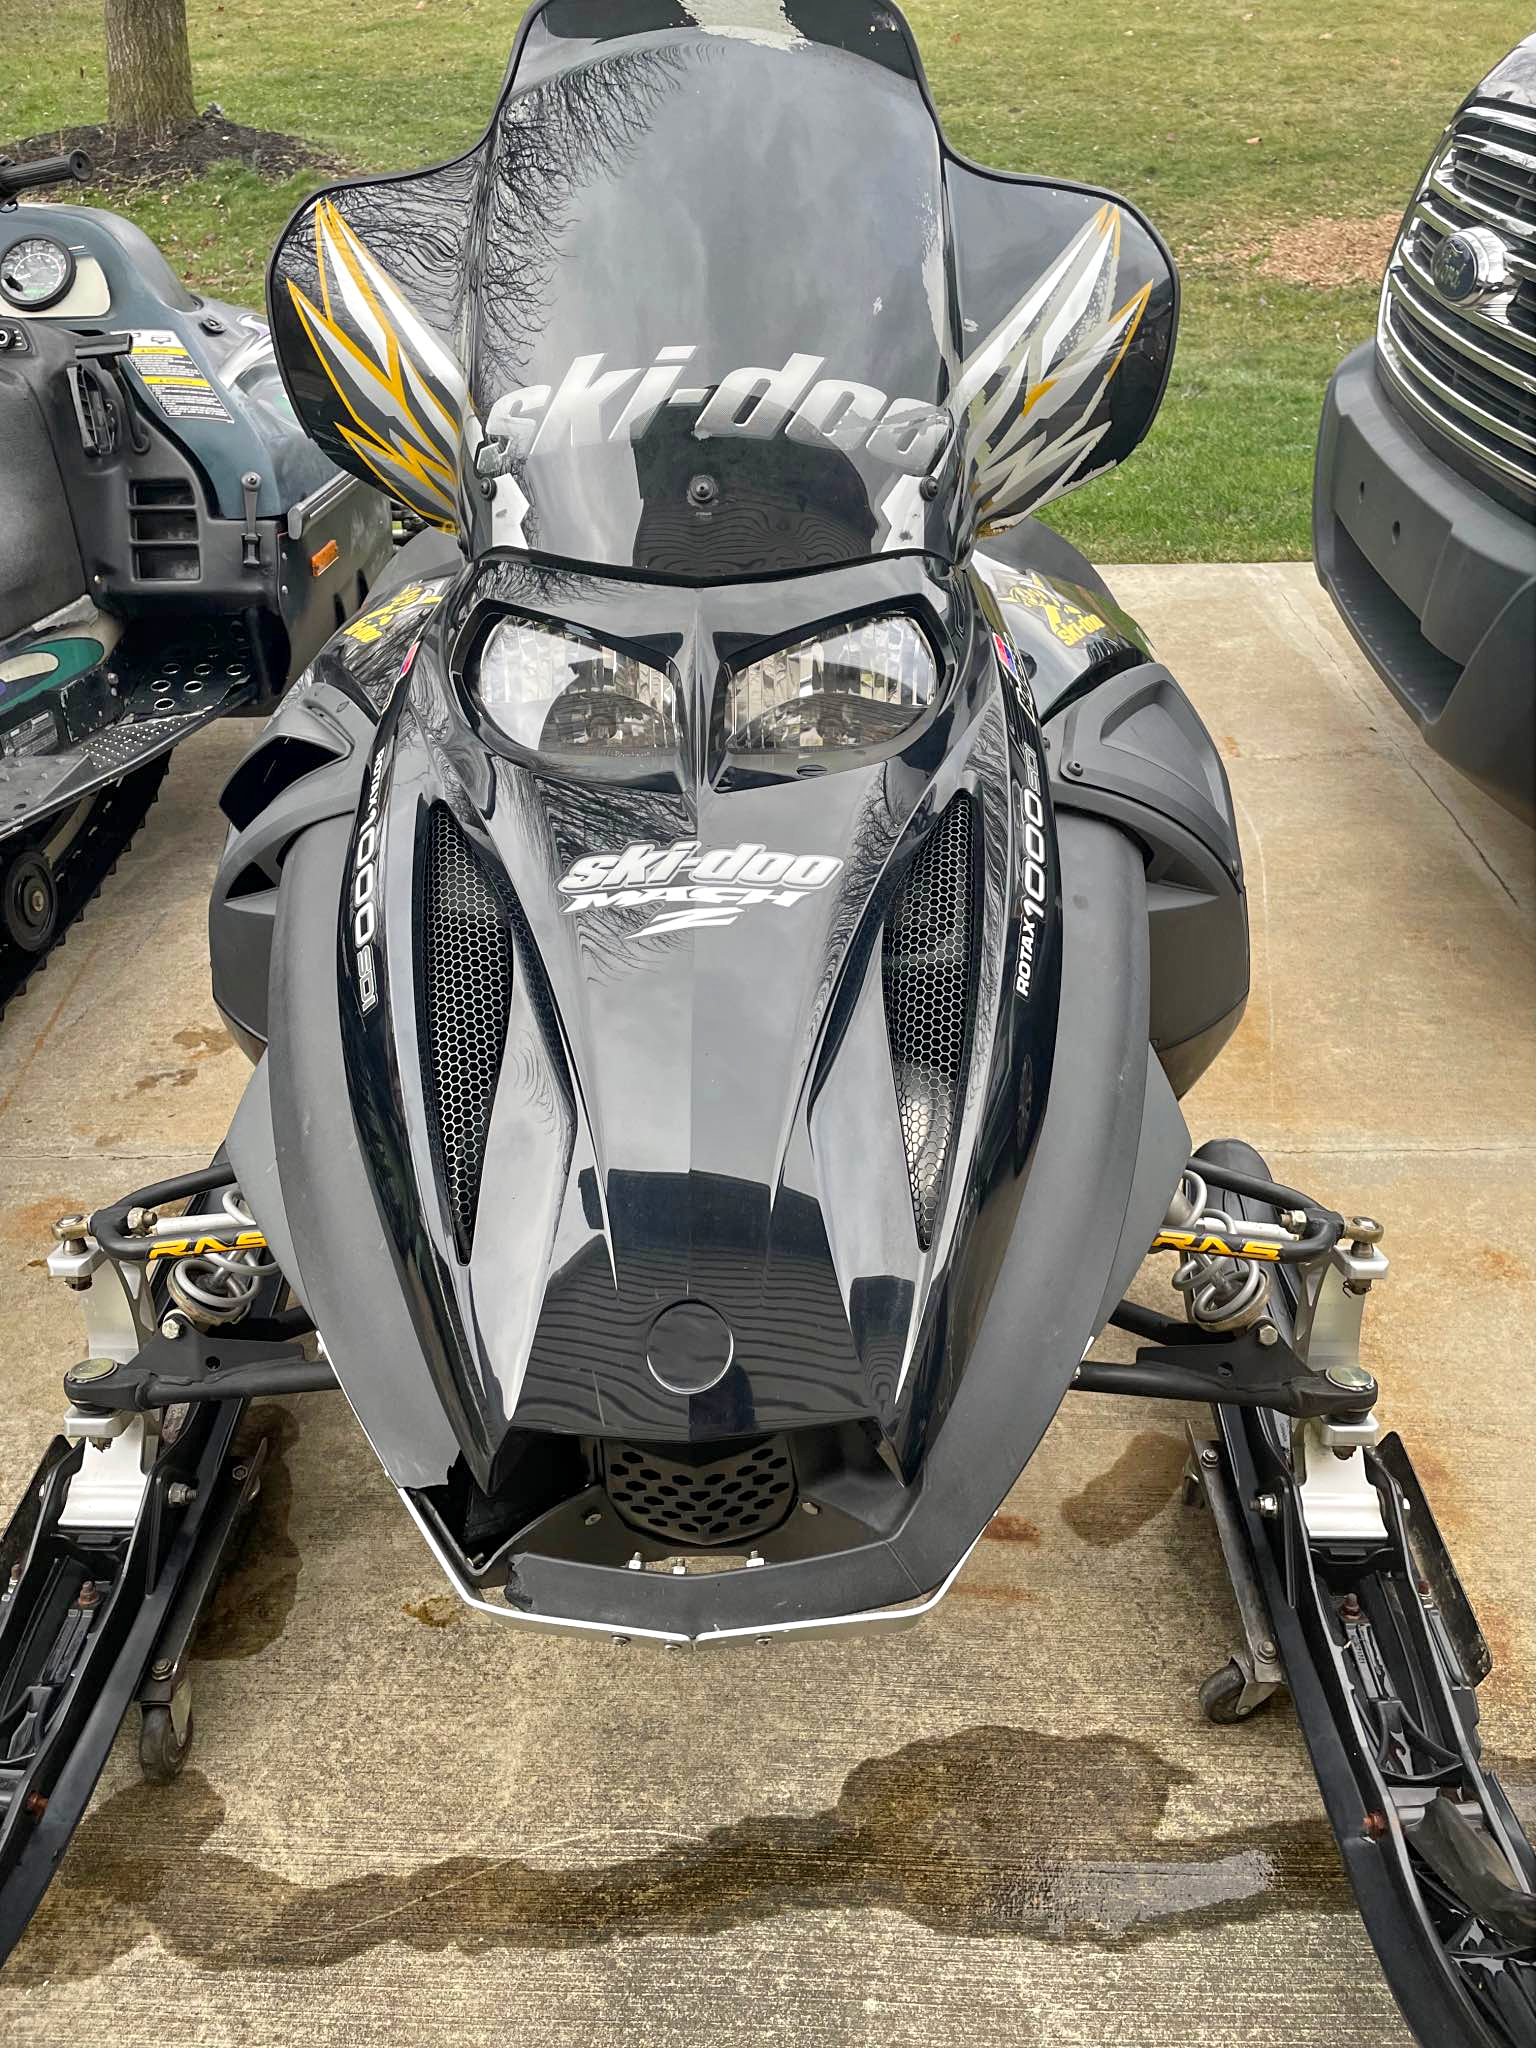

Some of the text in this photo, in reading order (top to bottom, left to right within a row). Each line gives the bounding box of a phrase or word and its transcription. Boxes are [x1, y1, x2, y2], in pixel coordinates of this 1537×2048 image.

[476, 345, 954, 475] ski-doo
[369, 747, 386, 811] ROTAX
[355, 807, 379, 947] 1000
[559, 840, 844, 893] ski-doo
[1023, 788, 1045, 921] 1000
[561, 885, 812, 913] MACH
[625, 906, 745, 939] Z
[1016, 917, 1035, 996] ROTAX
[148, 1230, 268, 1260] RAS
[1152, 1231, 1283, 1261] RAS
